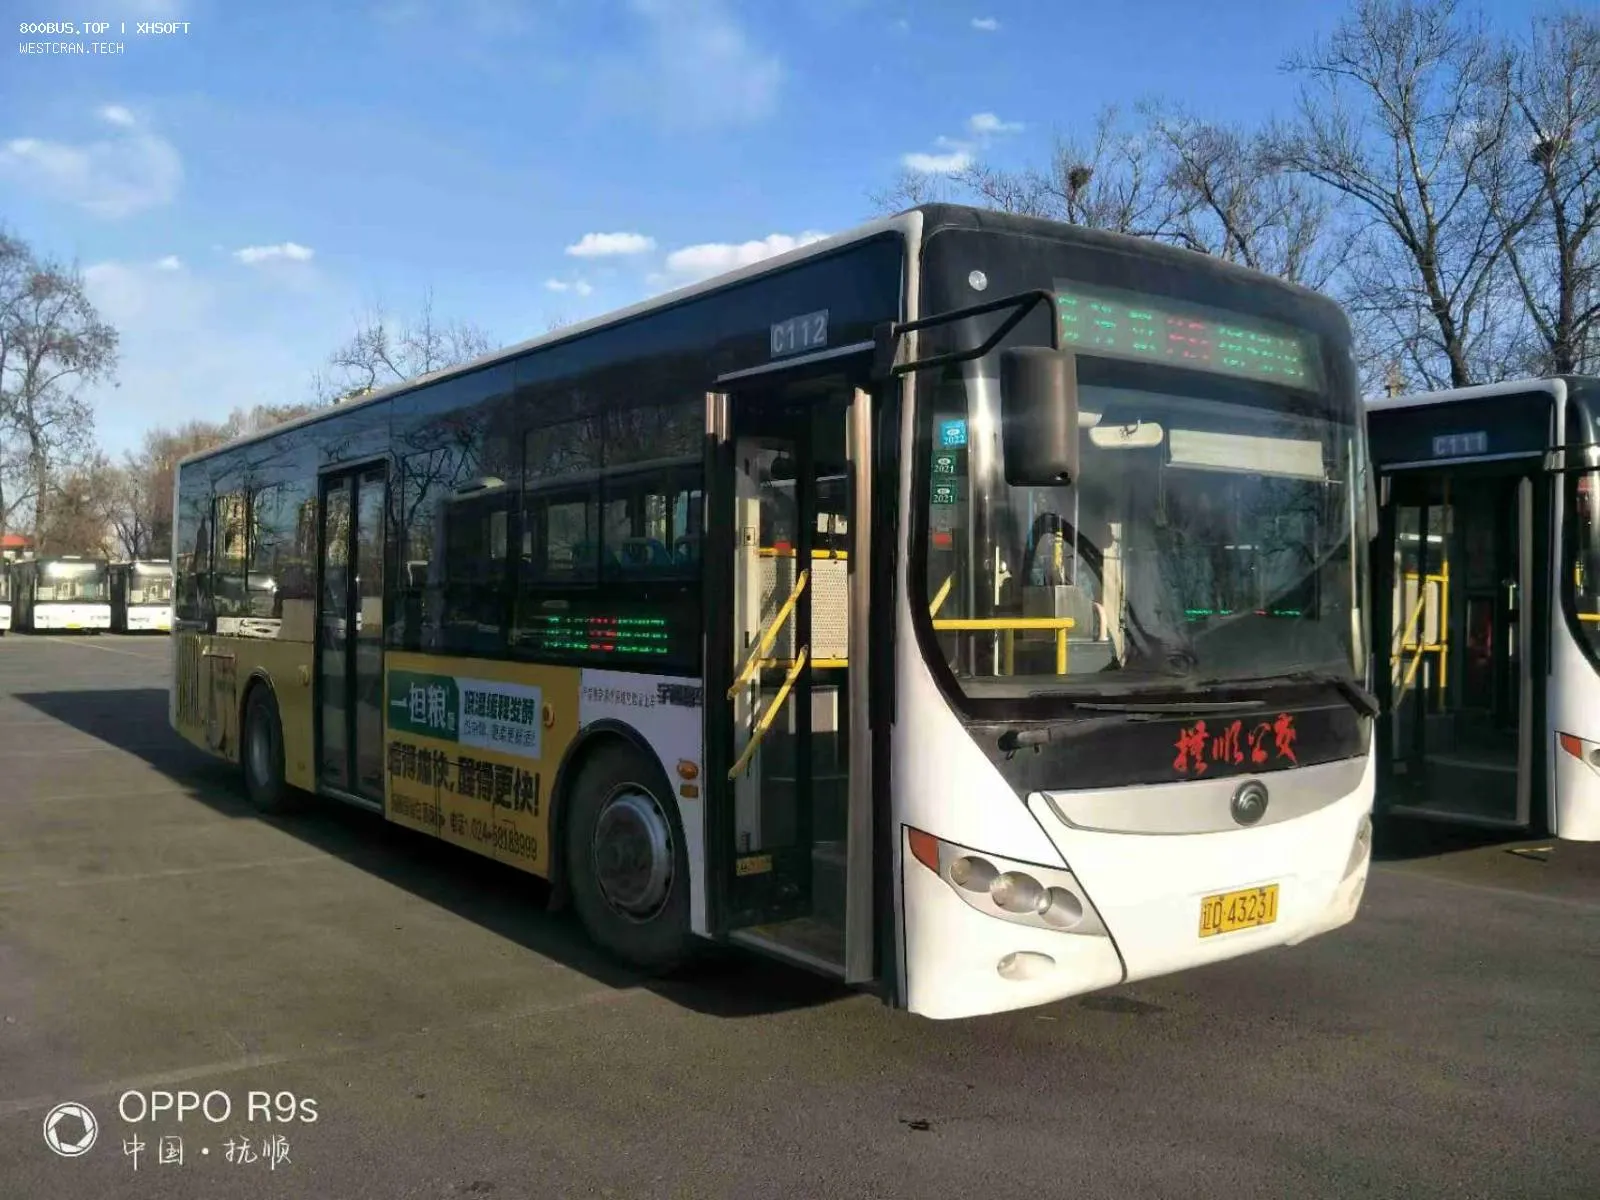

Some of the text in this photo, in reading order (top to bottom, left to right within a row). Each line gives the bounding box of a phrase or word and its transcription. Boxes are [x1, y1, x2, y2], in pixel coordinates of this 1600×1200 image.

[773, 315, 826, 353] C112
[1436, 432, 1484, 455] C111
[933, 464, 954, 474] 2021
[933, 494, 954, 504] 2021
